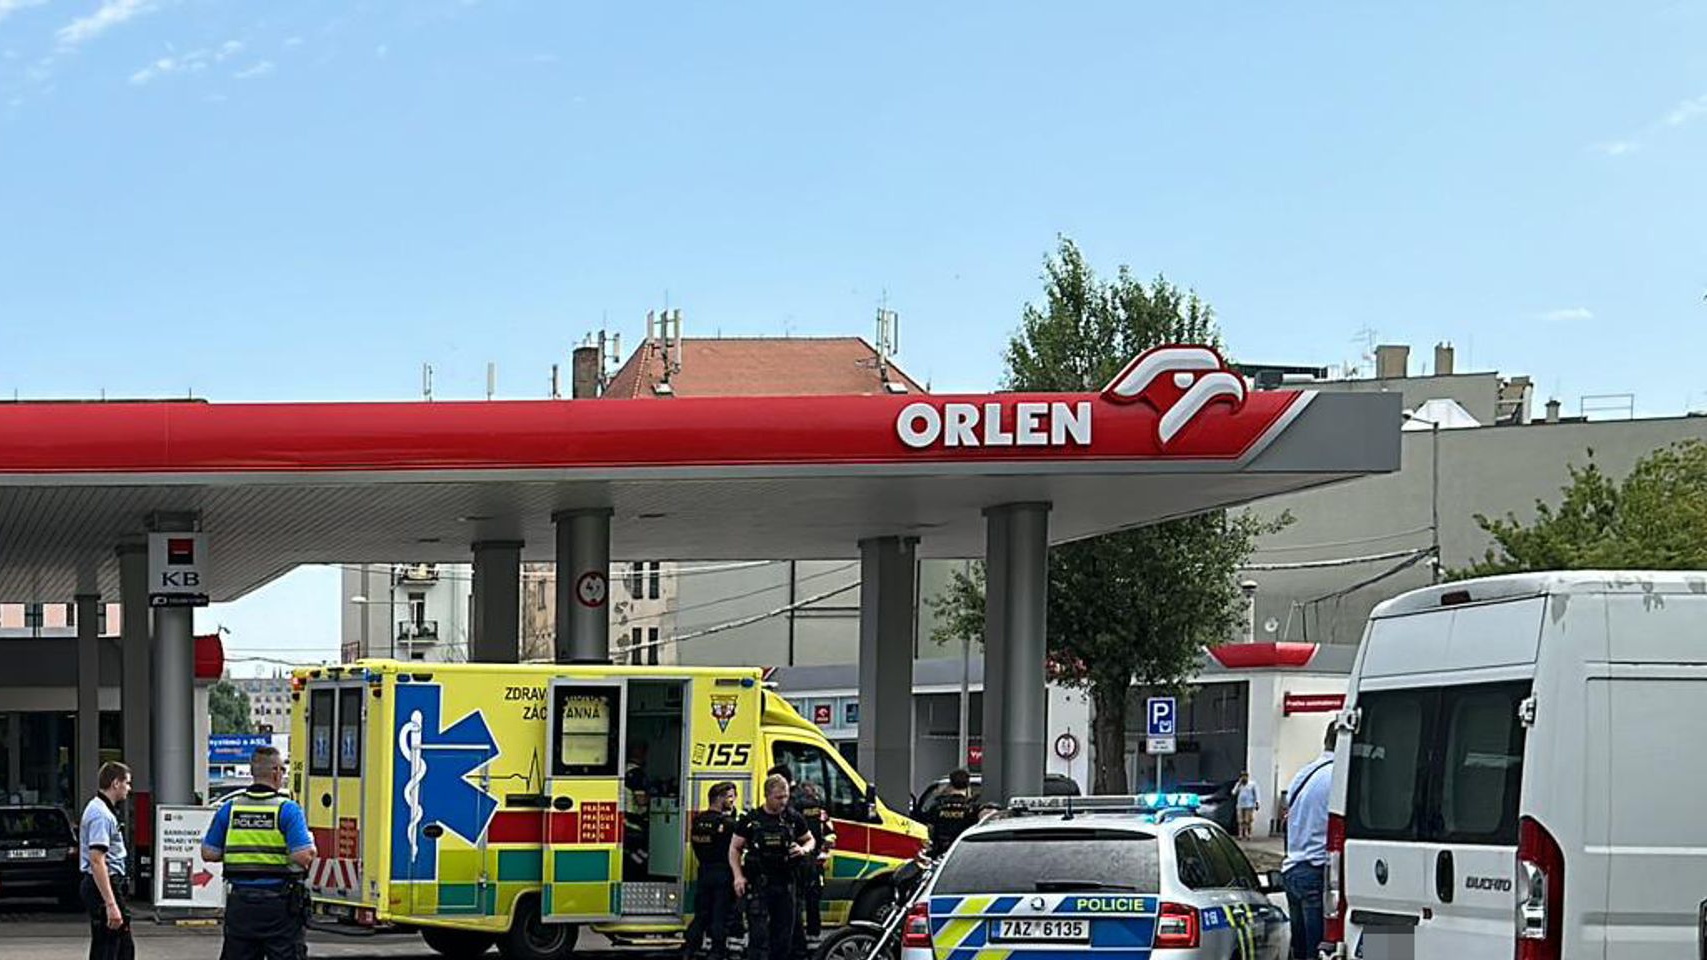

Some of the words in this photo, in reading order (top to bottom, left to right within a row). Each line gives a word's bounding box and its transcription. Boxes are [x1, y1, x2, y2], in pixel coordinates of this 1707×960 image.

[897, 402, 1092, 449] ORLEN
[162, 571, 199, 587] KB
[1153, 703, 1170, 725] P
[706, 743, 752, 766] 155
[1077, 898, 1145, 912] POLICIE
[1003, 919, 1032, 937] 7AZ
[1043, 919, 1083, 937] 6135
